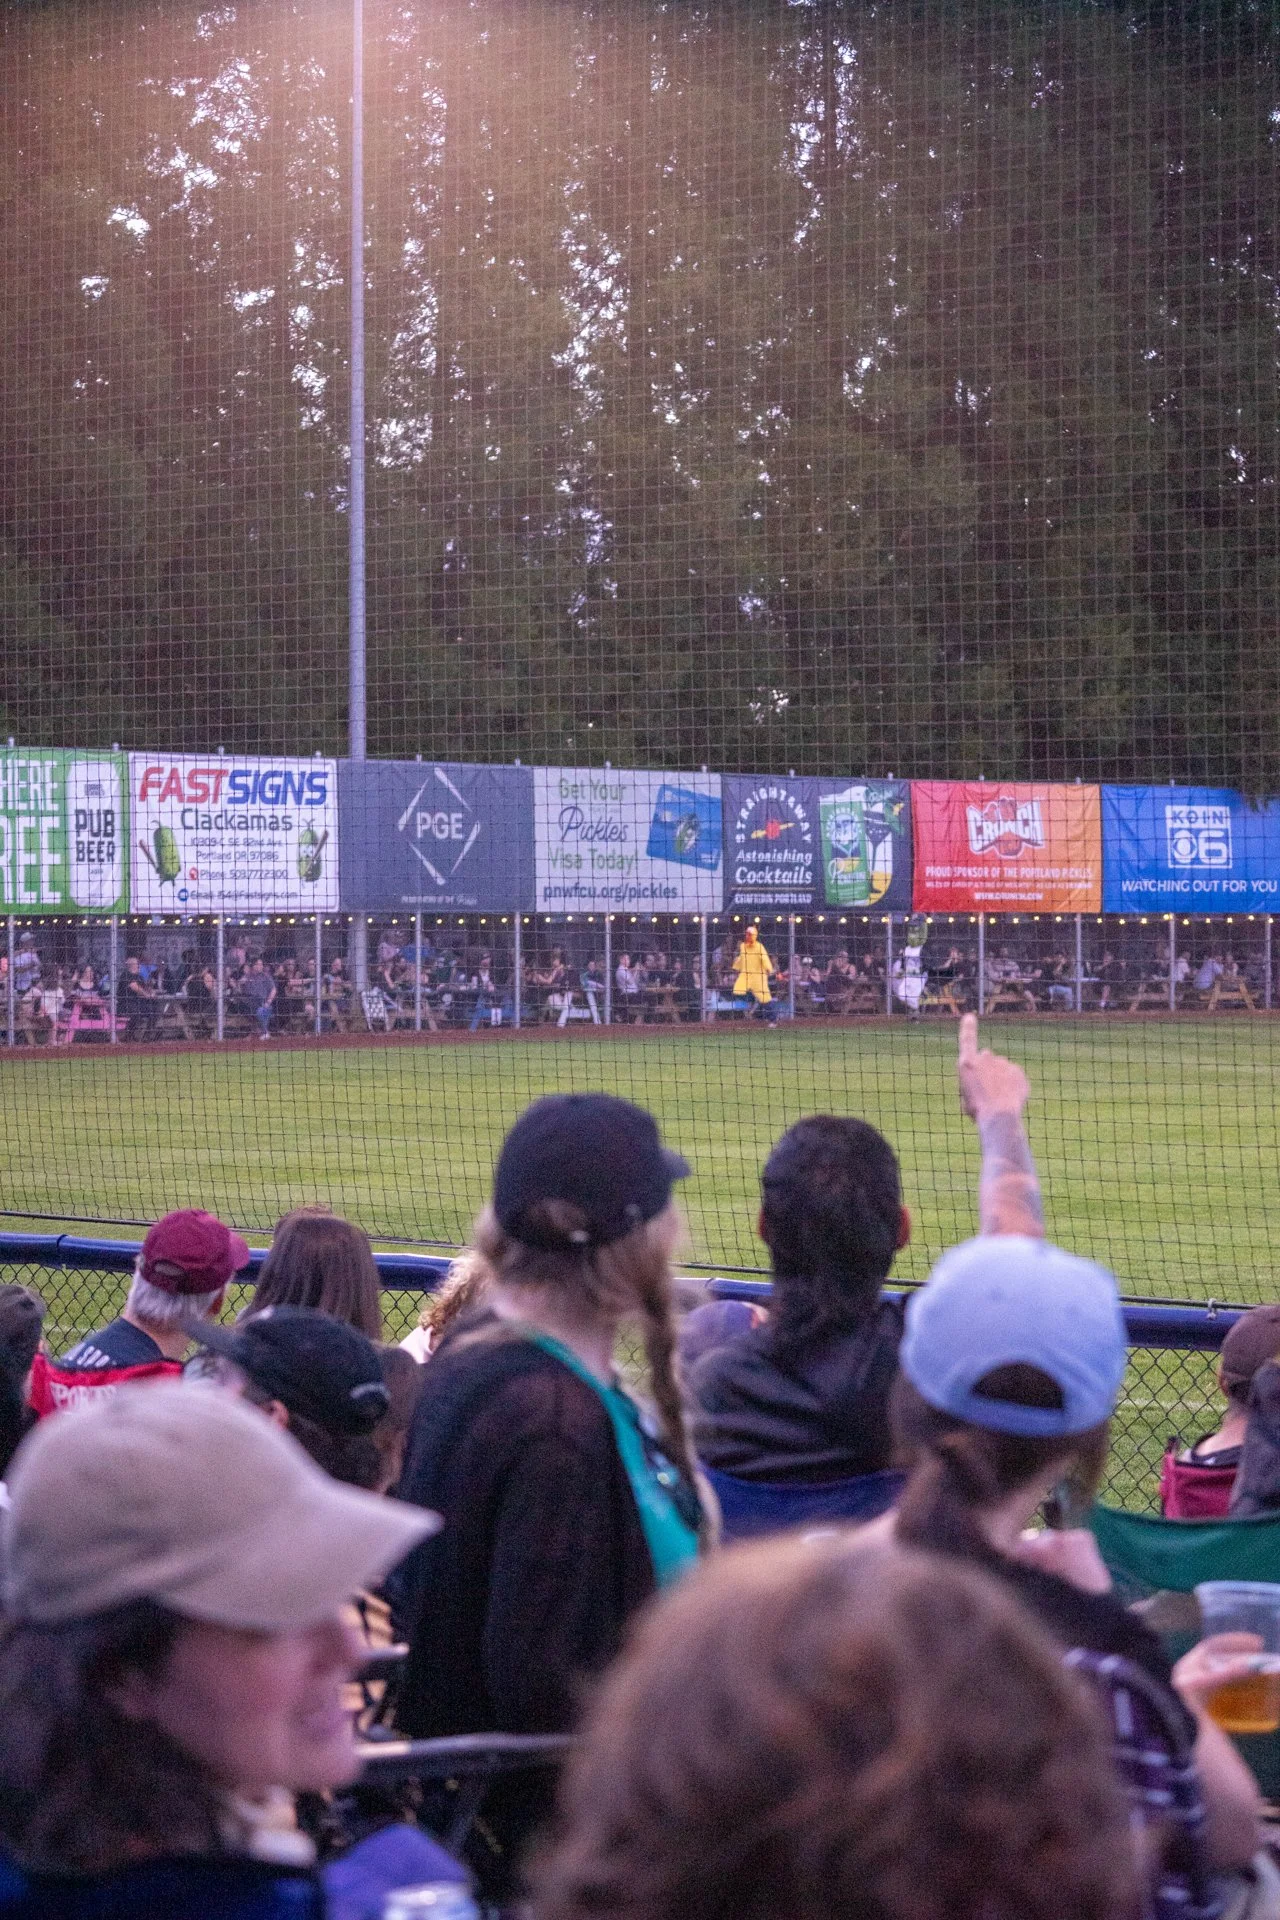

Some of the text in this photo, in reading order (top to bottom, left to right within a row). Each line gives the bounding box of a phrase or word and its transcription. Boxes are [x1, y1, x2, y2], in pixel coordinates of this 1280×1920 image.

[138, 766, 329, 806] FASTSIGNS
[559, 778, 627, 802] Get Your
[75, 809, 115, 838] PUB
[181, 808, 293, 831] Clackamas
[416, 811, 463, 840] PGE
[558, 805, 629, 843] Pickles
[735, 786, 812, 843] STRAIGHTAWAY
[966, 797, 1043, 853] CRUNCH
[1172, 810, 1225, 825] KOIN
[75, 840, 116, 862] BEER
[549, 847, 639, 875] Visa Today!
[735, 849, 813, 865] Astonishing
[735, 866, 813, 885] Cocktails
[925, 866, 951, 878] PROUD
[954, 867, 988, 878] SPONSOR
[991, 867, 1001, 878] OF
[1004, 867, 1018, 878] THE
[543, 882, 678, 903] pnwfcu.org/pickles
[1122, 878, 1278, 892] WATCHING OUT FOR YOU
